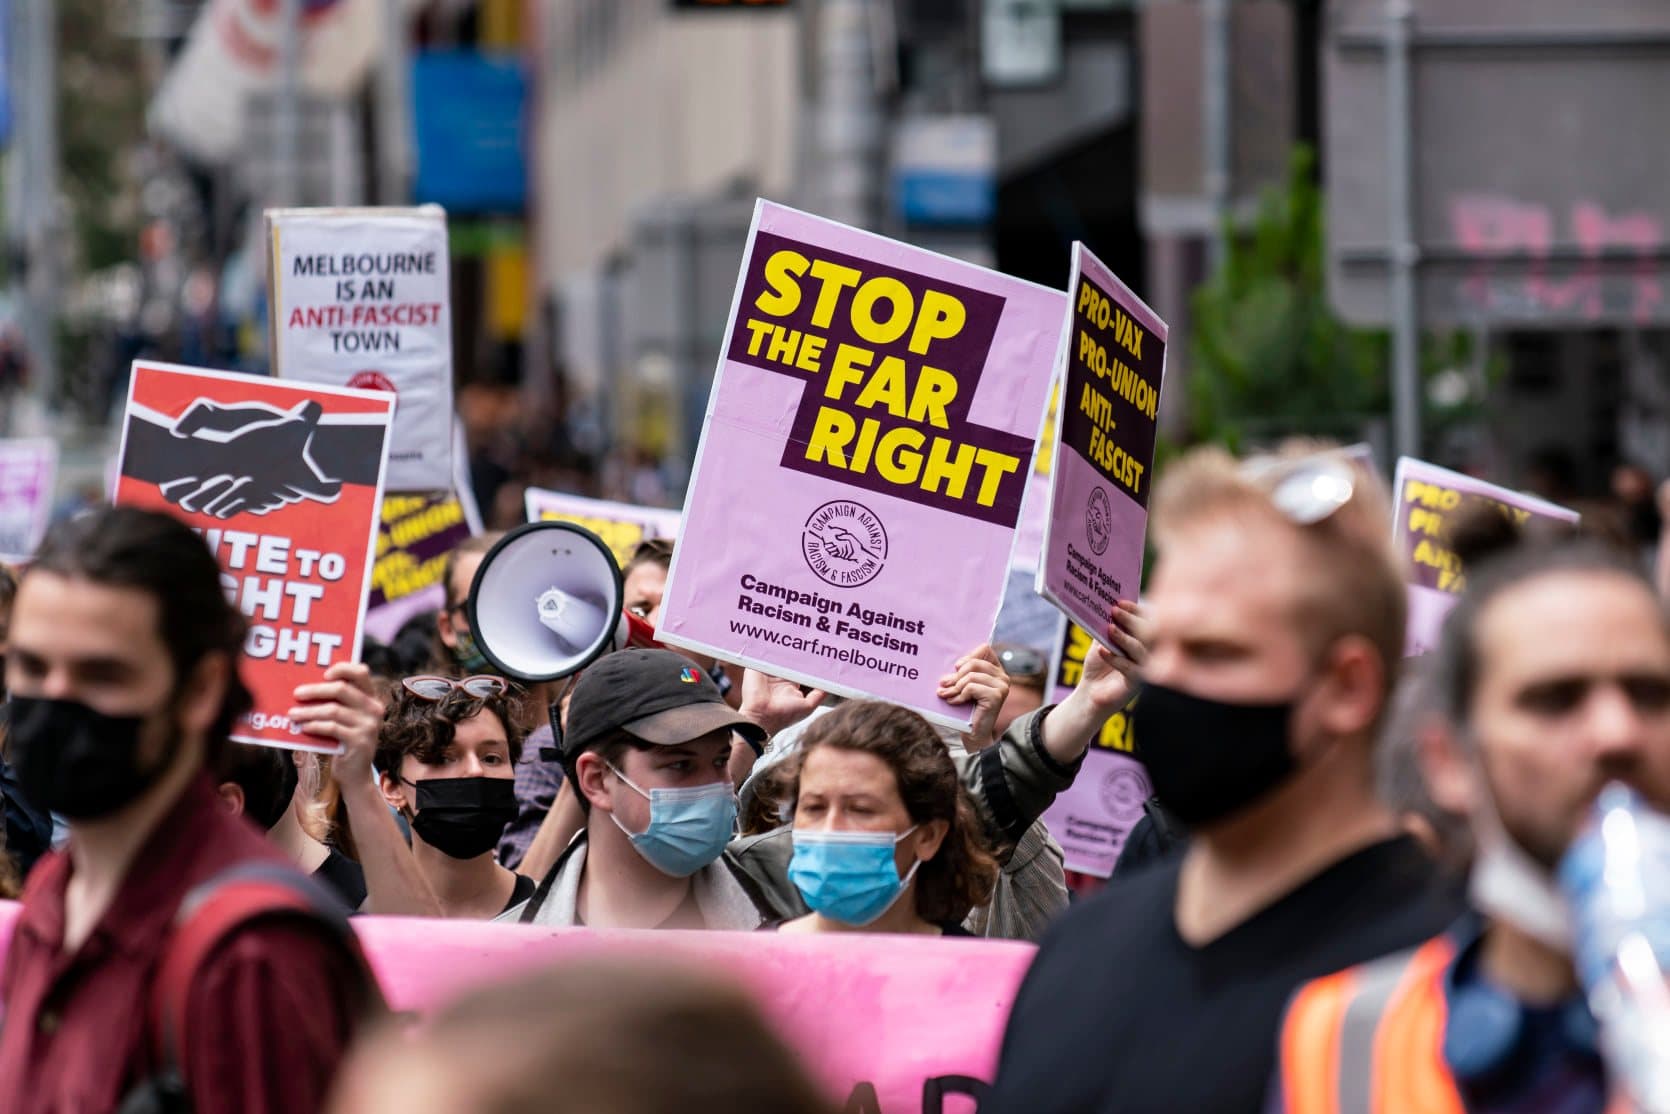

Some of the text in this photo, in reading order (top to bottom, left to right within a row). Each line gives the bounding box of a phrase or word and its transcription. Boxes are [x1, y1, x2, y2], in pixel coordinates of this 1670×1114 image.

[293, 252, 436, 277] MELBOURNE
[336, 279, 395, 301] IS AN
[289, 303, 441, 329] ANTI-FASCIST
[755, 250, 966, 356] STOP
[1078, 281, 1144, 361] PRO-VAX
[330, 330, 400, 353] TOWN
[746, 318, 828, 373] THE
[824, 343, 958, 430] FAR
[1079, 330, 1158, 422] PRO-UNION
[1079, 382, 1117, 434] ANTI-
[805, 405, 1021, 508] RIGHT
[1088, 424, 1144, 494] FASCIST
[812, 504, 882, 552] CAMPAIGN AGAINST
[295, 548, 345, 581] TO
[807, 541, 877, 584] RACISM & FASCISM
[1066, 559, 1089, 587] Racism
[1067, 543, 1121, 595] Campaign Against
[737, 594, 919, 656] Racism & Fascism
[740, 574, 926, 636] Campaign Against
[244, 624, 342, 667] GHT
[729, 620, 920, 681] www.carf.melbourne
